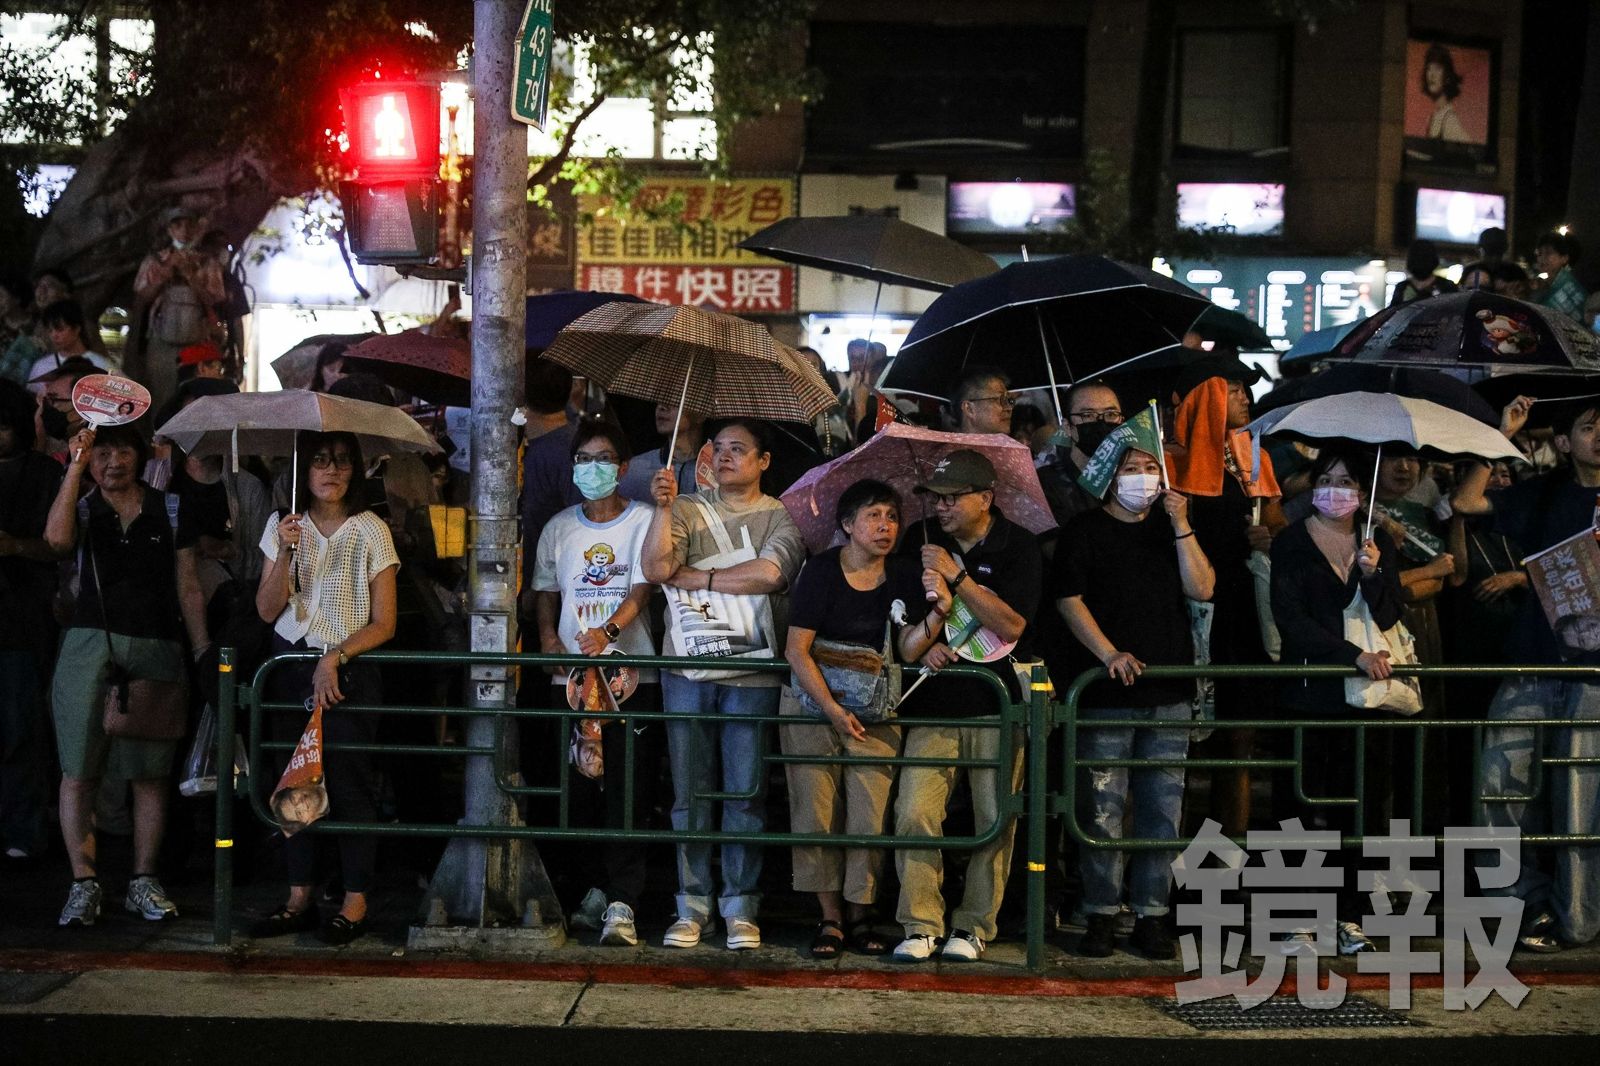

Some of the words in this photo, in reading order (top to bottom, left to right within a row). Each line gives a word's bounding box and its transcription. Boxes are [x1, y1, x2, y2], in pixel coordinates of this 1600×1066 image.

[529, 24, 546, 57] 43
[524, 78, 539, 111] 79
[588, 267, 782, 309] 證件快照
[597, 590, 627, 598] Running
